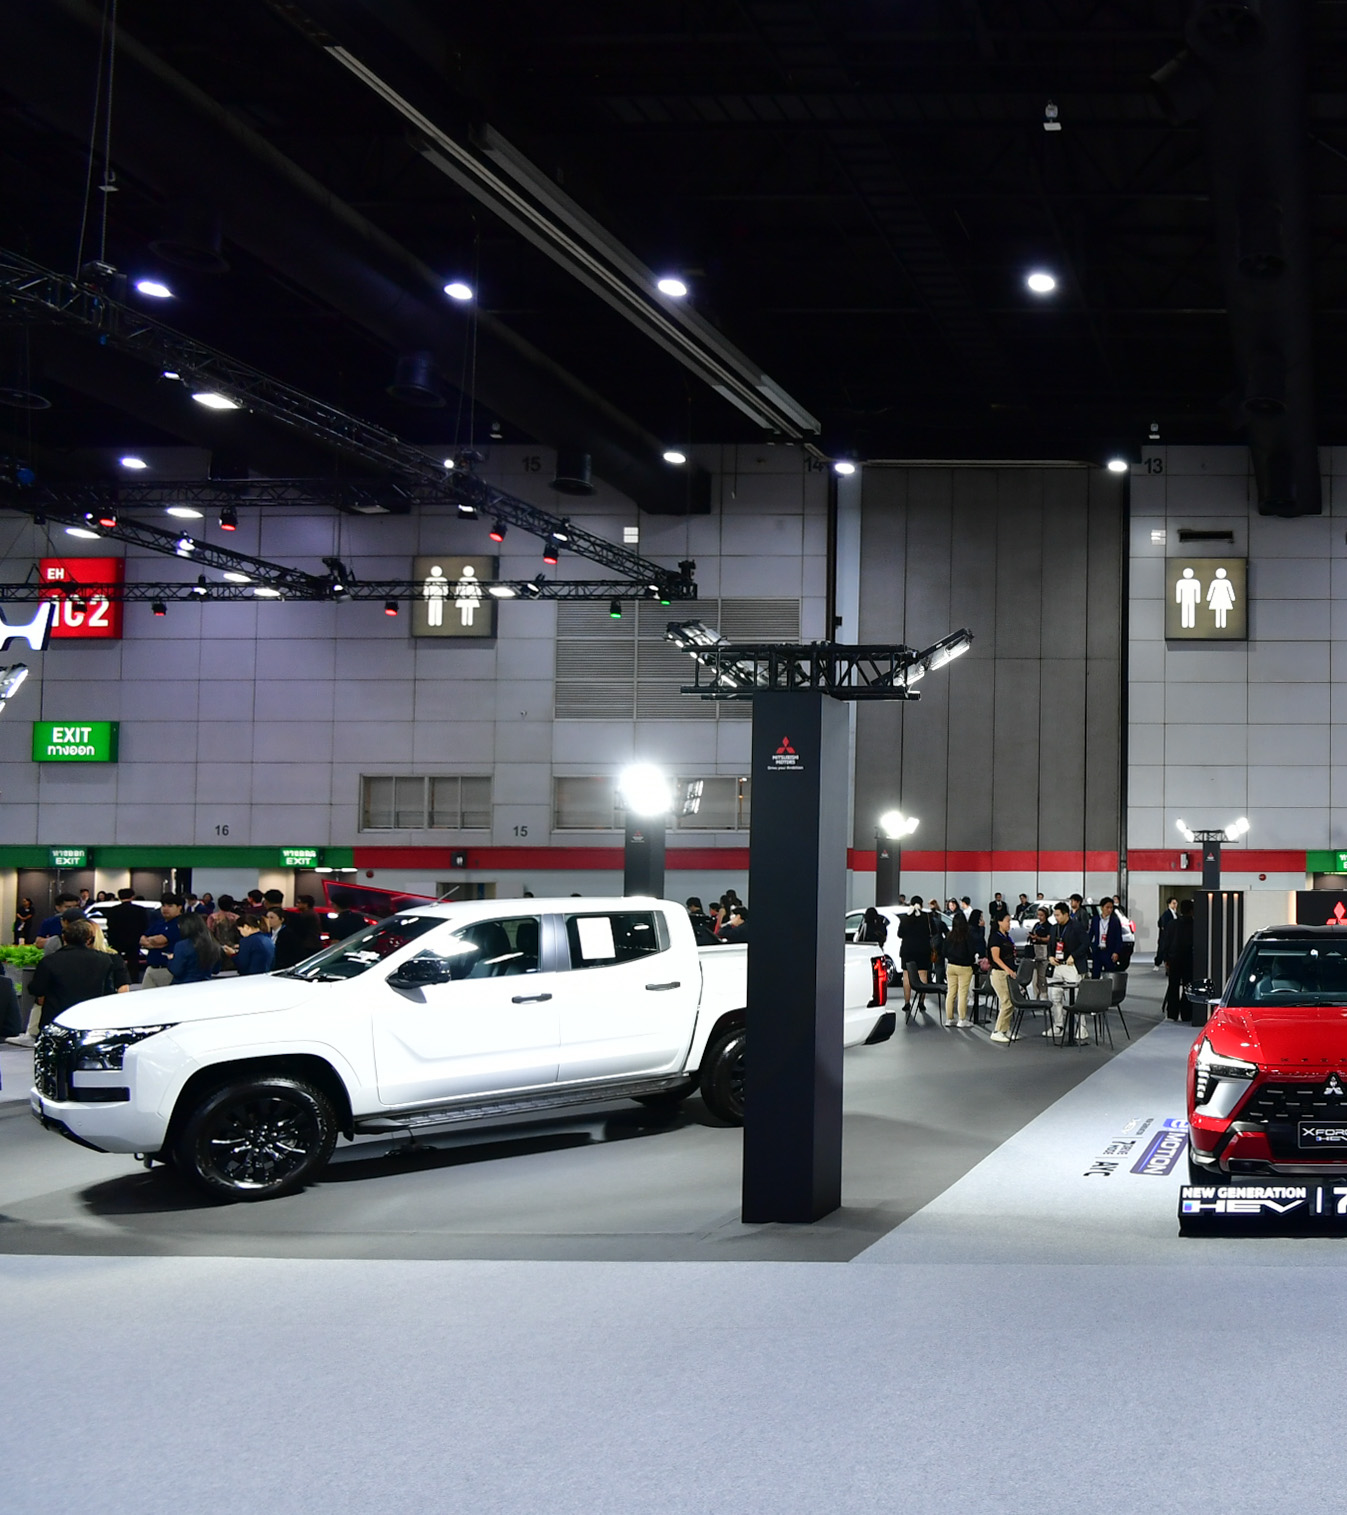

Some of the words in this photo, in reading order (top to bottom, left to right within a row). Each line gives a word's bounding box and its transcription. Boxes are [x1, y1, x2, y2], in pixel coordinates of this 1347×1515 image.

[522, 456, 541, 472] 15
[1144, 458, 1163, 474] 13
[47, 568, 64, 579] EH
[52, 727, 92, 743] EXIT
[47, 745, 95, 756] ทางออก
[215, 825, 229, 836] 16
[513, 826, 528, 837] 15
[55, 857, 81, 865] EXIT
[286, 857, 312, 865] EXIT
[1083, 1161, 1119, 1176] AYC
[1182, 1187, 1216, 1198] NEW
[1217, 1187, 1306, 1199] GENERATION
[1182, 1200, 1306, 1213] HEV
